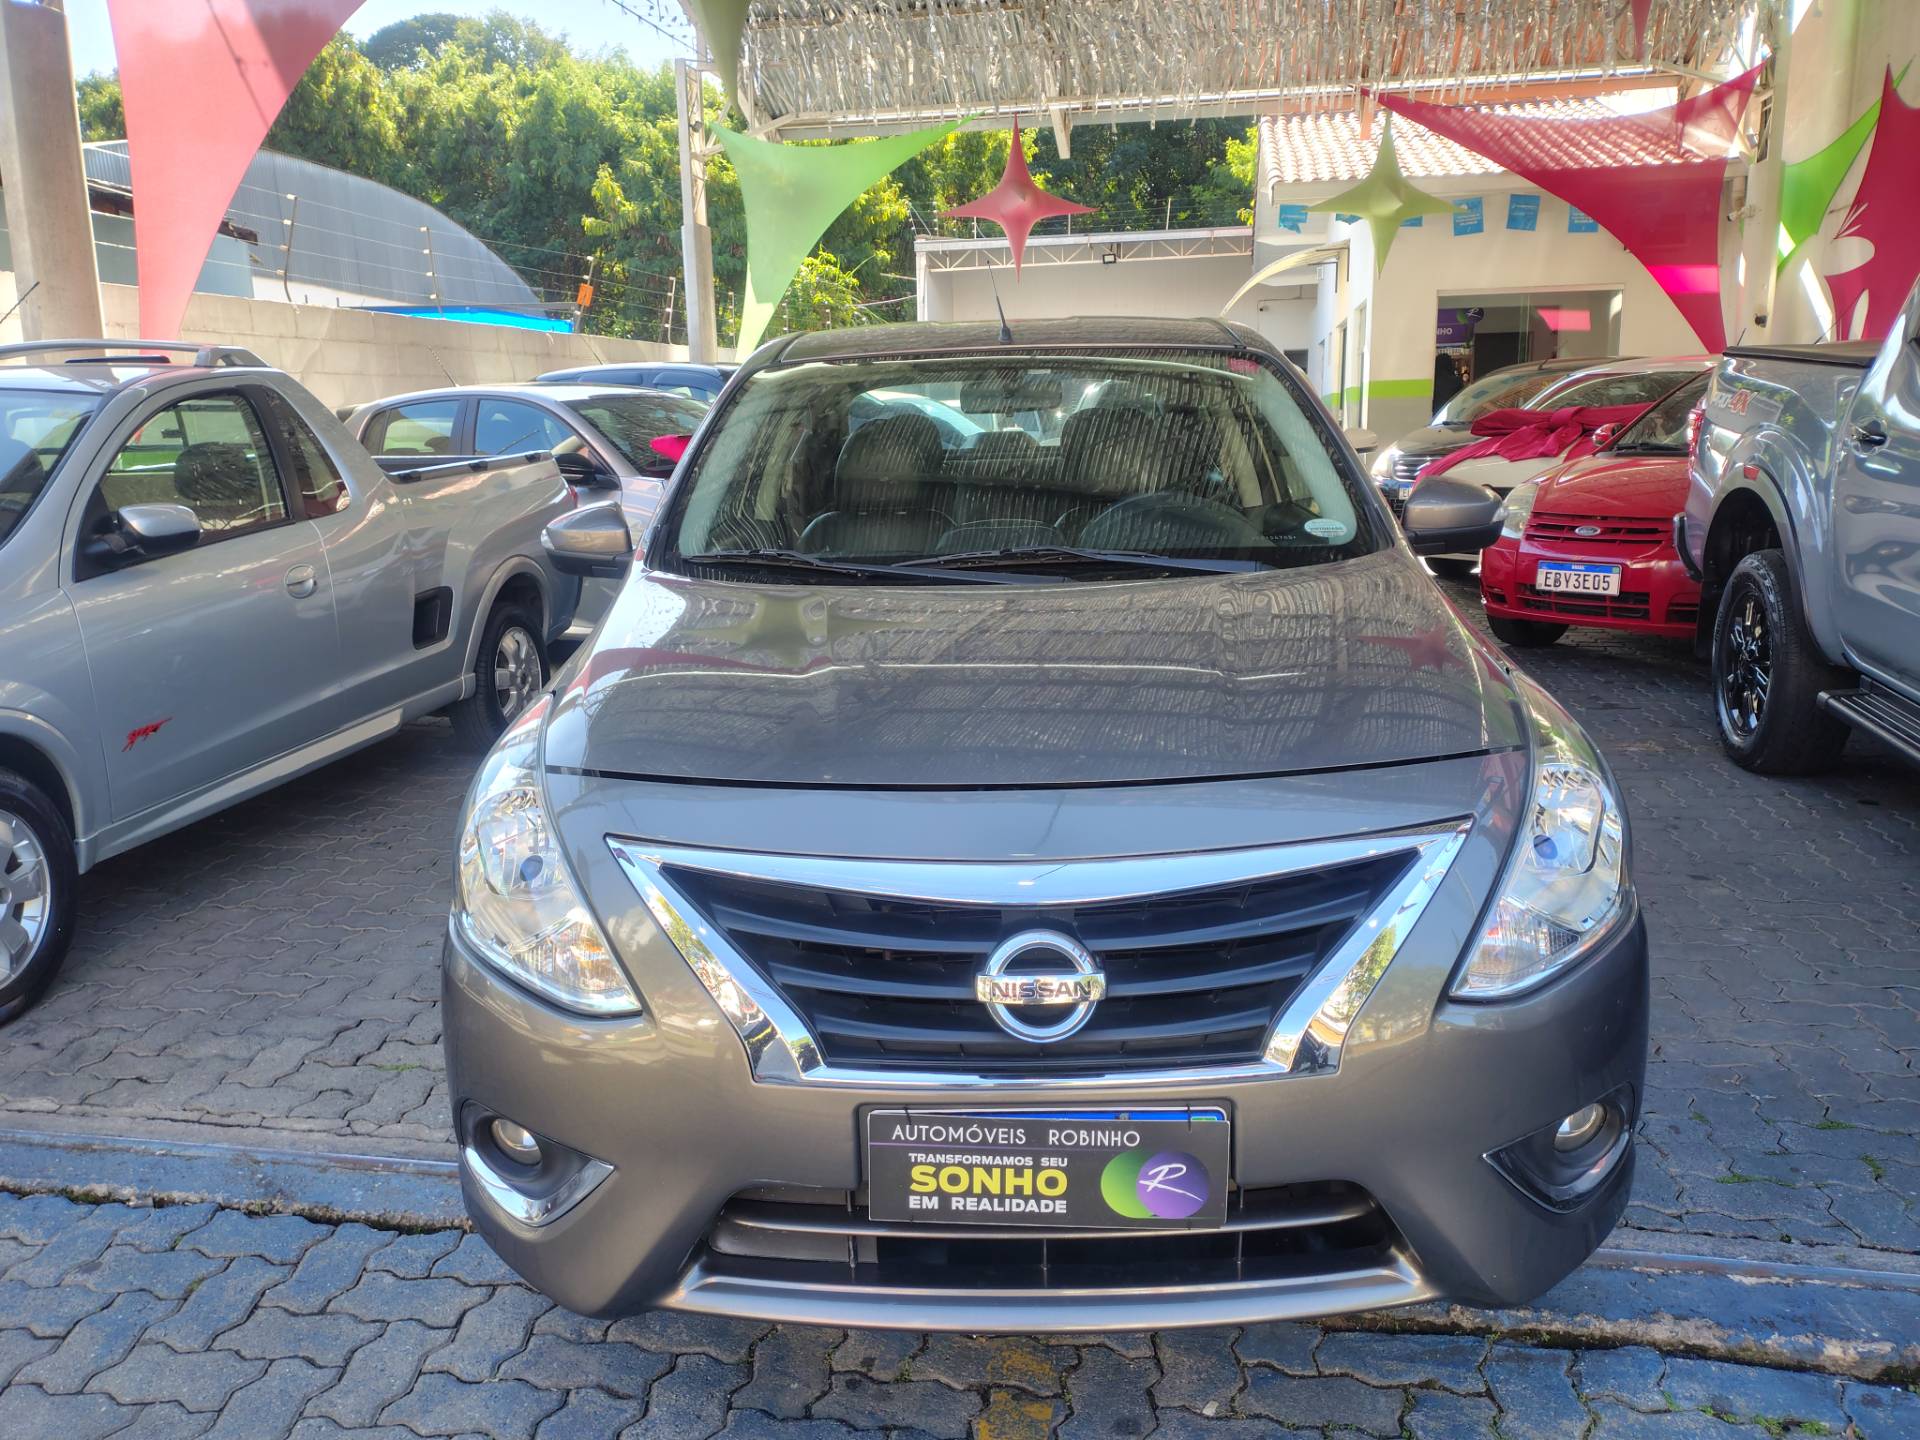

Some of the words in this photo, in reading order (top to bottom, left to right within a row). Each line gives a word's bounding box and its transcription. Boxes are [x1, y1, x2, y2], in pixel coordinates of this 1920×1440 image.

[1544, 571, 1611, 591] EBY3E05
[990, 980, 1093, 999] NISSAN
[891, 1123, 1026, 1145] AUTOMÓVEIS
[1048, 1128, 1141, 1147] ROBINHO
[908, 1152, 1034, 1167] TRANSFORMAMOS
[1040, 1157, 1068, 1167] SEU
[910, 1165, 1068, 1197] SONHO
[908, 1196, 939, 1209] EM
[951, 1197, 1067, 1213] REALIDADE
